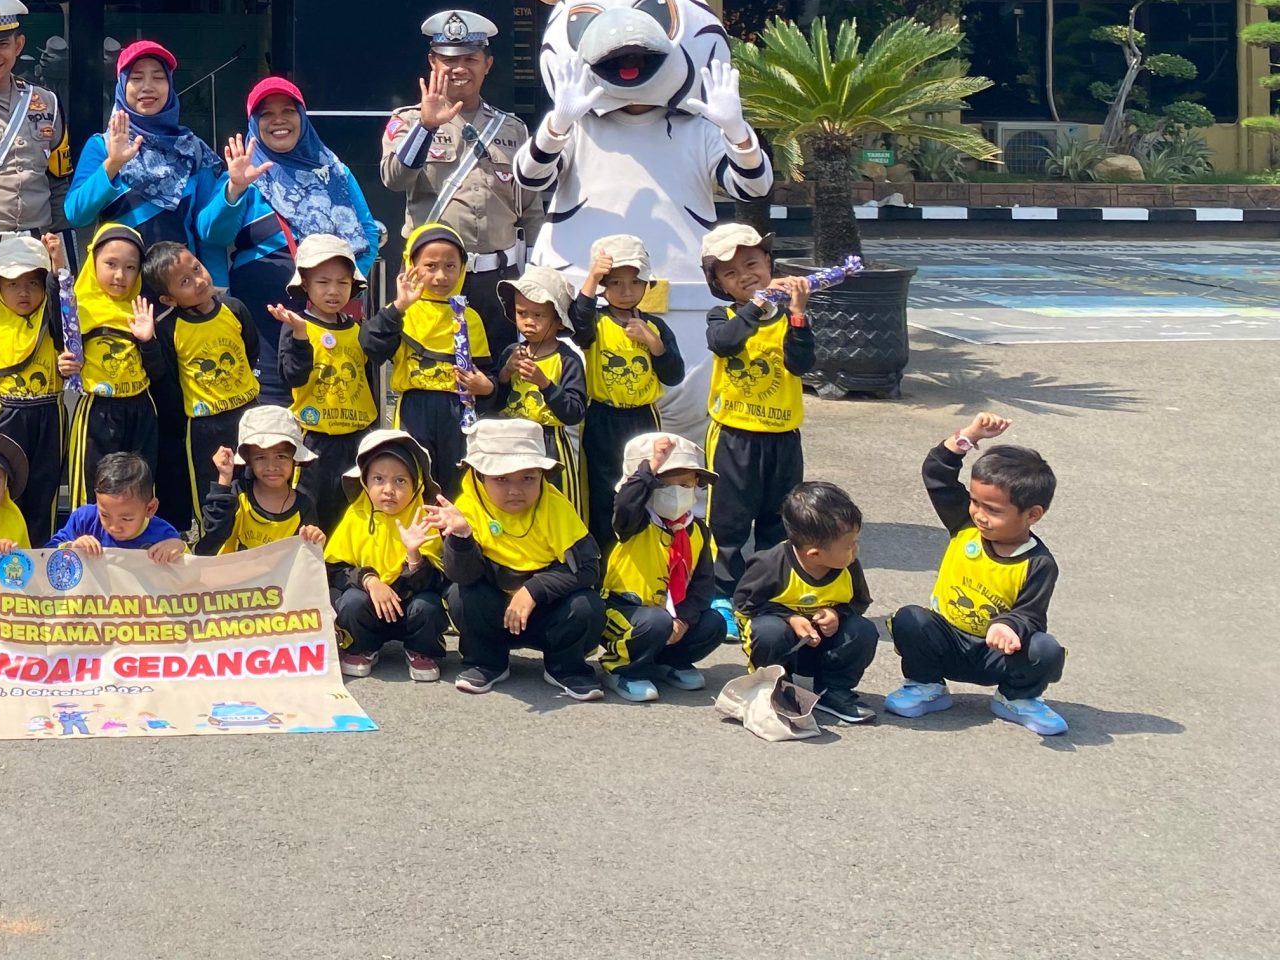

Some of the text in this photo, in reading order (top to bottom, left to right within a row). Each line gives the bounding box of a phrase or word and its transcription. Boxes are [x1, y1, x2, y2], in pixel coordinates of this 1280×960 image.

[493, 137, 517, 147] OLRI
[322, 408, 340, 420] PAUD
[340, 408, 358, 421] NUSA
[724, 399, 745, 413] PAUD
[747, 403, 766, 418] NUSA
[1, 596, 140, 616] PENGENALAN
[145, 596, 199, 616] LALU
[203, 589, 281, 613] LINTAS
[0, 620, 100, 643] BERSAMA
[103, 623, 187, 643] POLRES
[191, 611, 320, 640] LAMONGAN
[113, 643, 326, 679] GEDANGAN
[10, 686, 24, 697] 8
